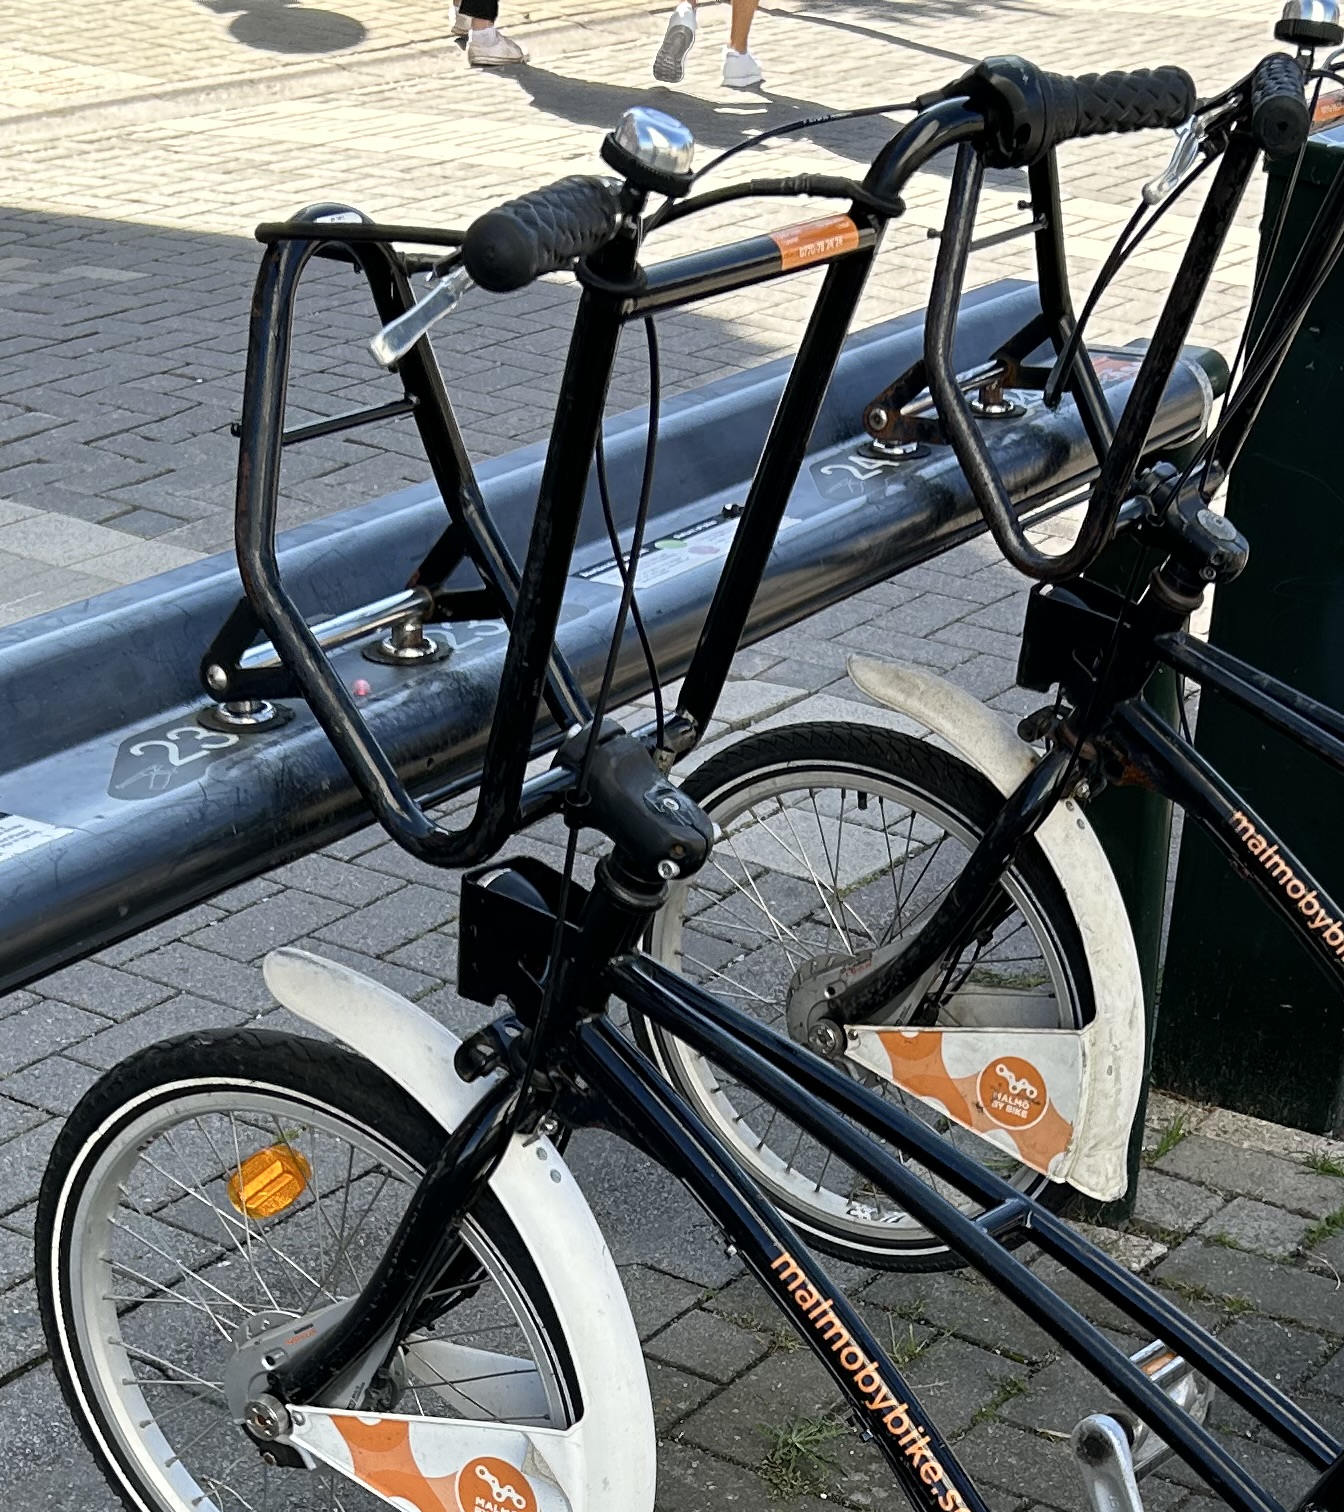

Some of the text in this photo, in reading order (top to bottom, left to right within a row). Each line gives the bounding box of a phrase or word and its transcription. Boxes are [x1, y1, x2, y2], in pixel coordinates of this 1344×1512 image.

[820, 455, 900, 480] 24
[129, 726, 240, 766] 23
[992, 1102, 1028, 1118] BY BIKE
